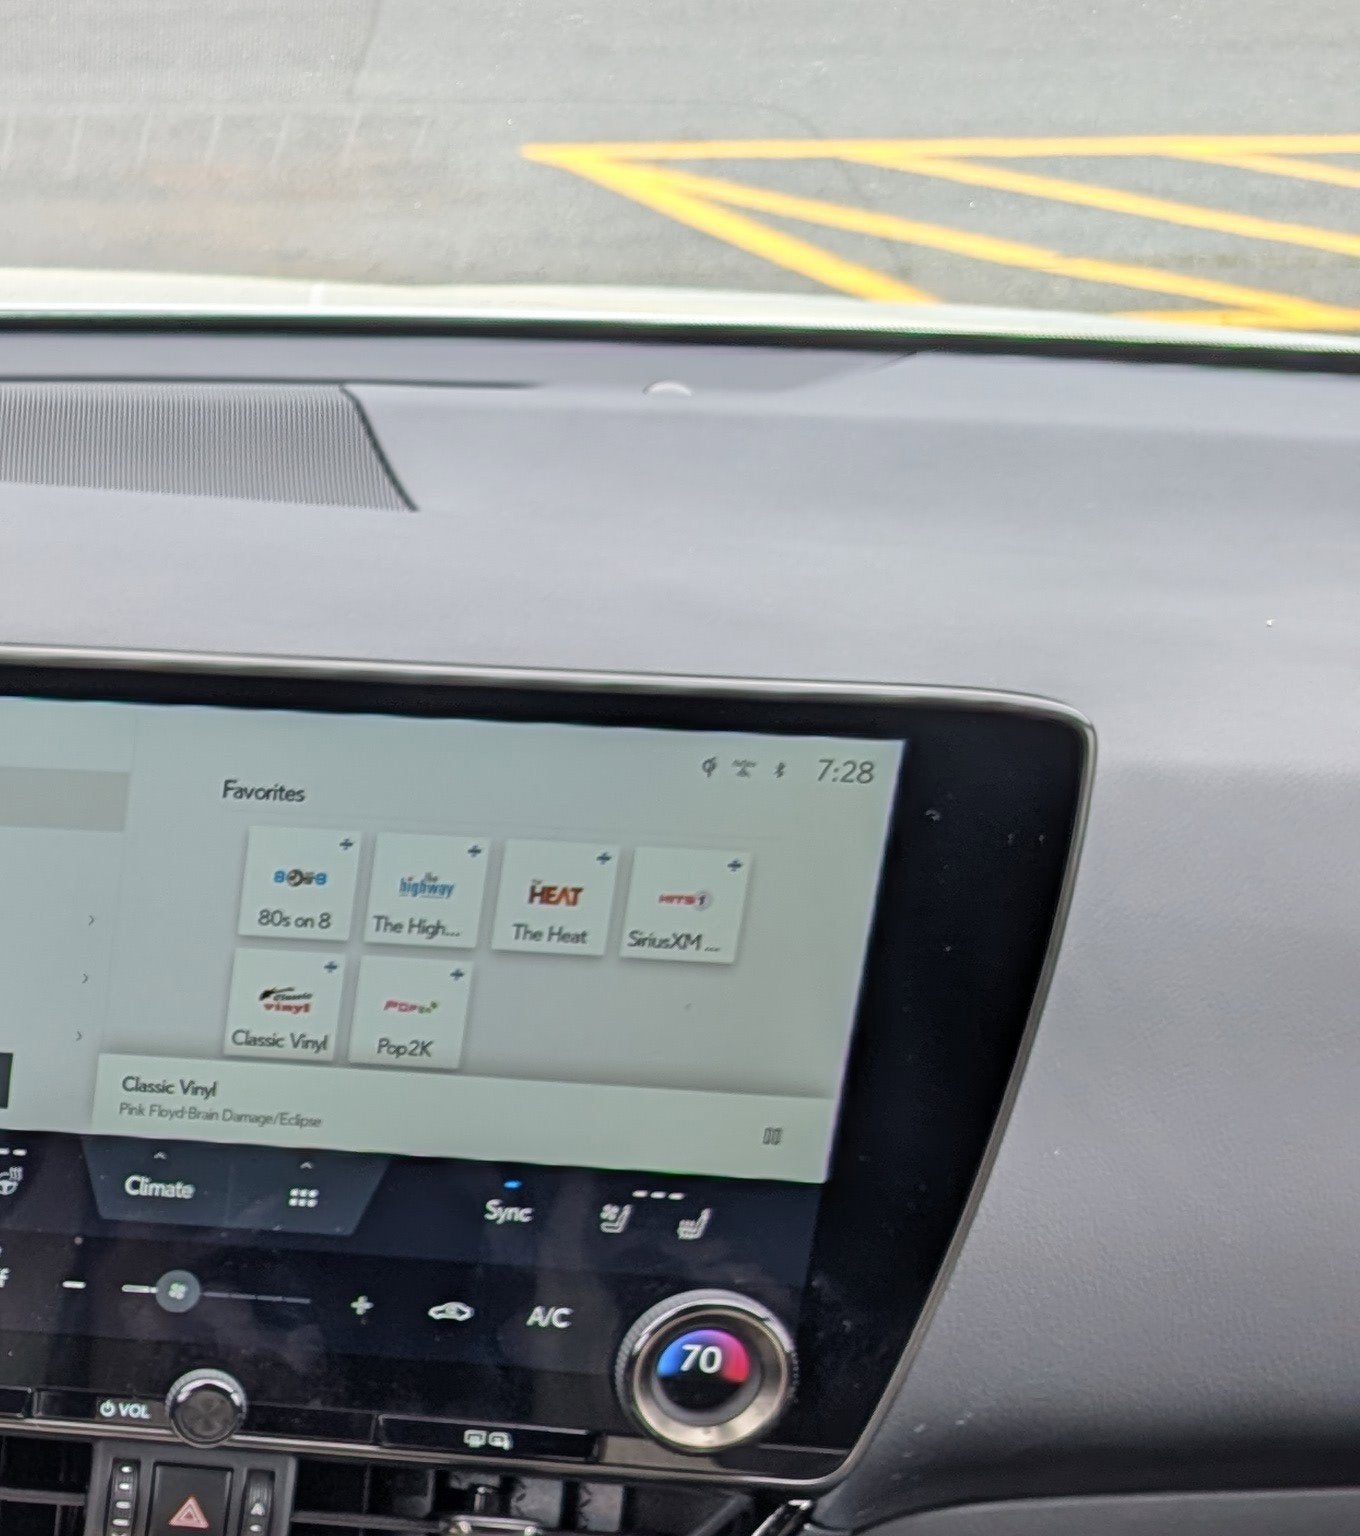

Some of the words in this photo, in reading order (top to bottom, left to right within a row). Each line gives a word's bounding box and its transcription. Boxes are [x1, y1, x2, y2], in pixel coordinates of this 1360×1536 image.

[817, 758, 875, 784] 7:28
[222, 779, 306, 804] Favorites
[528, 885, 584, 907] HEAT
[257, 909, 292, 928] 80s
[294, 915, 315, 929] on
[318, 911, 332, 930] 8
[373, 914, 404, 935] The
[512, 923, 543, 942] The
[547, 926, 589, 945] Heat
[627, 930, 703, 952] SiriusXM
[232, 1029, 285, 1050] Classic
[290, 1033, 329, 1054] Vinyl
[377, 1038, 434, 1059] Pop2K
[122, 1076, 176, 1096] Classic
[179, 1079, 218, 1100] Vinyl
[119, 1102, 145, 1117] Pink
[221, 1108, 322, 1129] Damage/Eclipse
[124, 1174, 196, 1201] Climate
[484, 1199, 535, 1225] Sync
[526, 1305, 573, 1329] A/C
[680, 1344, 722, 1375] 70
[118, 1402, 152, 1420] VOL
